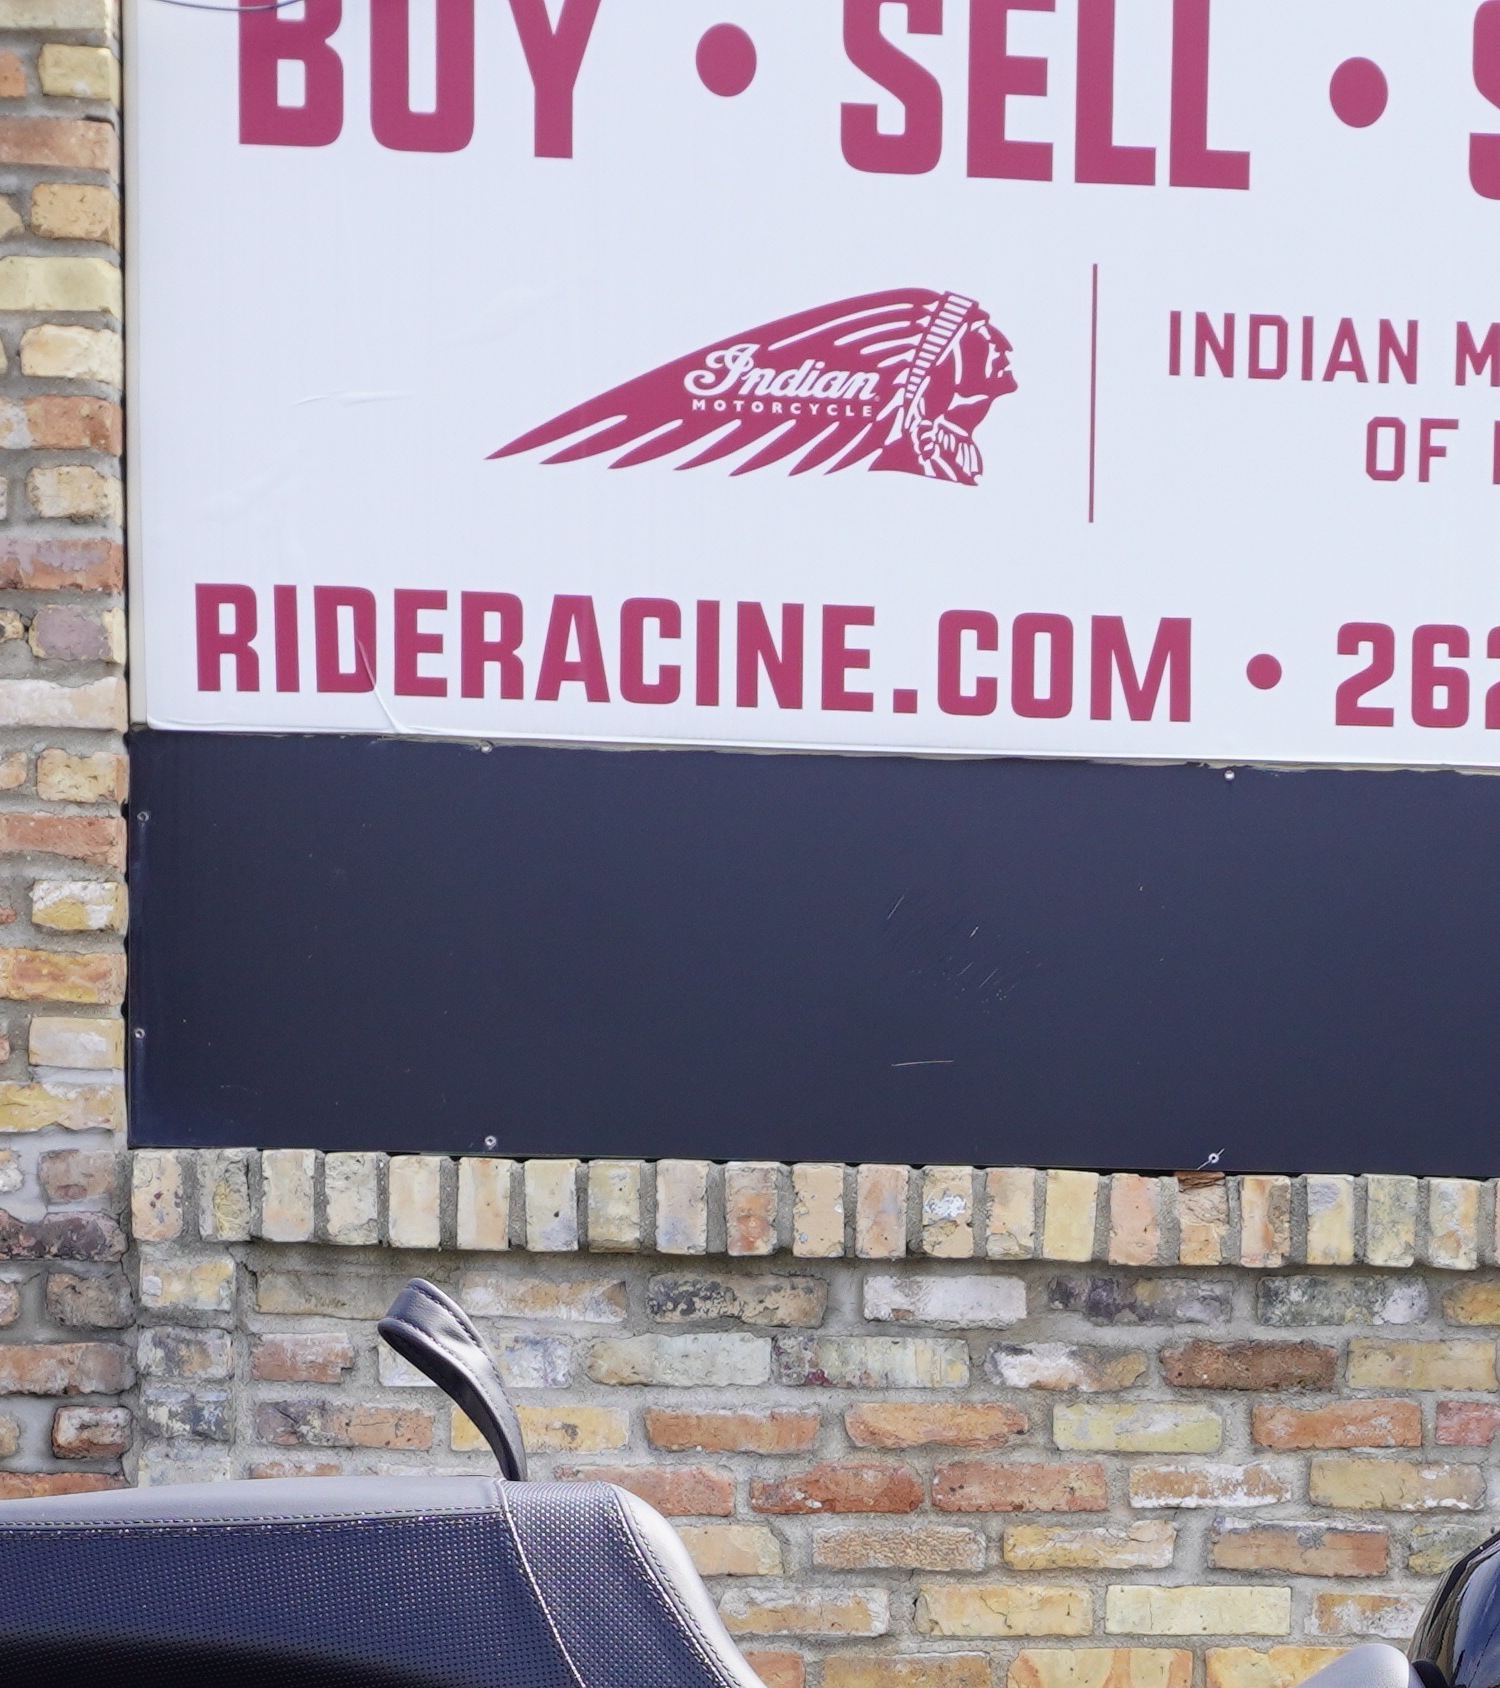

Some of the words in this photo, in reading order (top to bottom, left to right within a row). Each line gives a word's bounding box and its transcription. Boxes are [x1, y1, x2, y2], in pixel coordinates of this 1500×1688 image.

[240, 0, 599, 157] BUY
[842, 0, 1249, 189] SELL
[683, 343, 880, 401] Indian
[1171, 313, 1416, 382] INDIAN
[691, 399, 874, 418] MOTORCYCLE
[1367, 418, 1456, 480] OF
[197, 585, 1190, 721] RIDERACINE.COM
